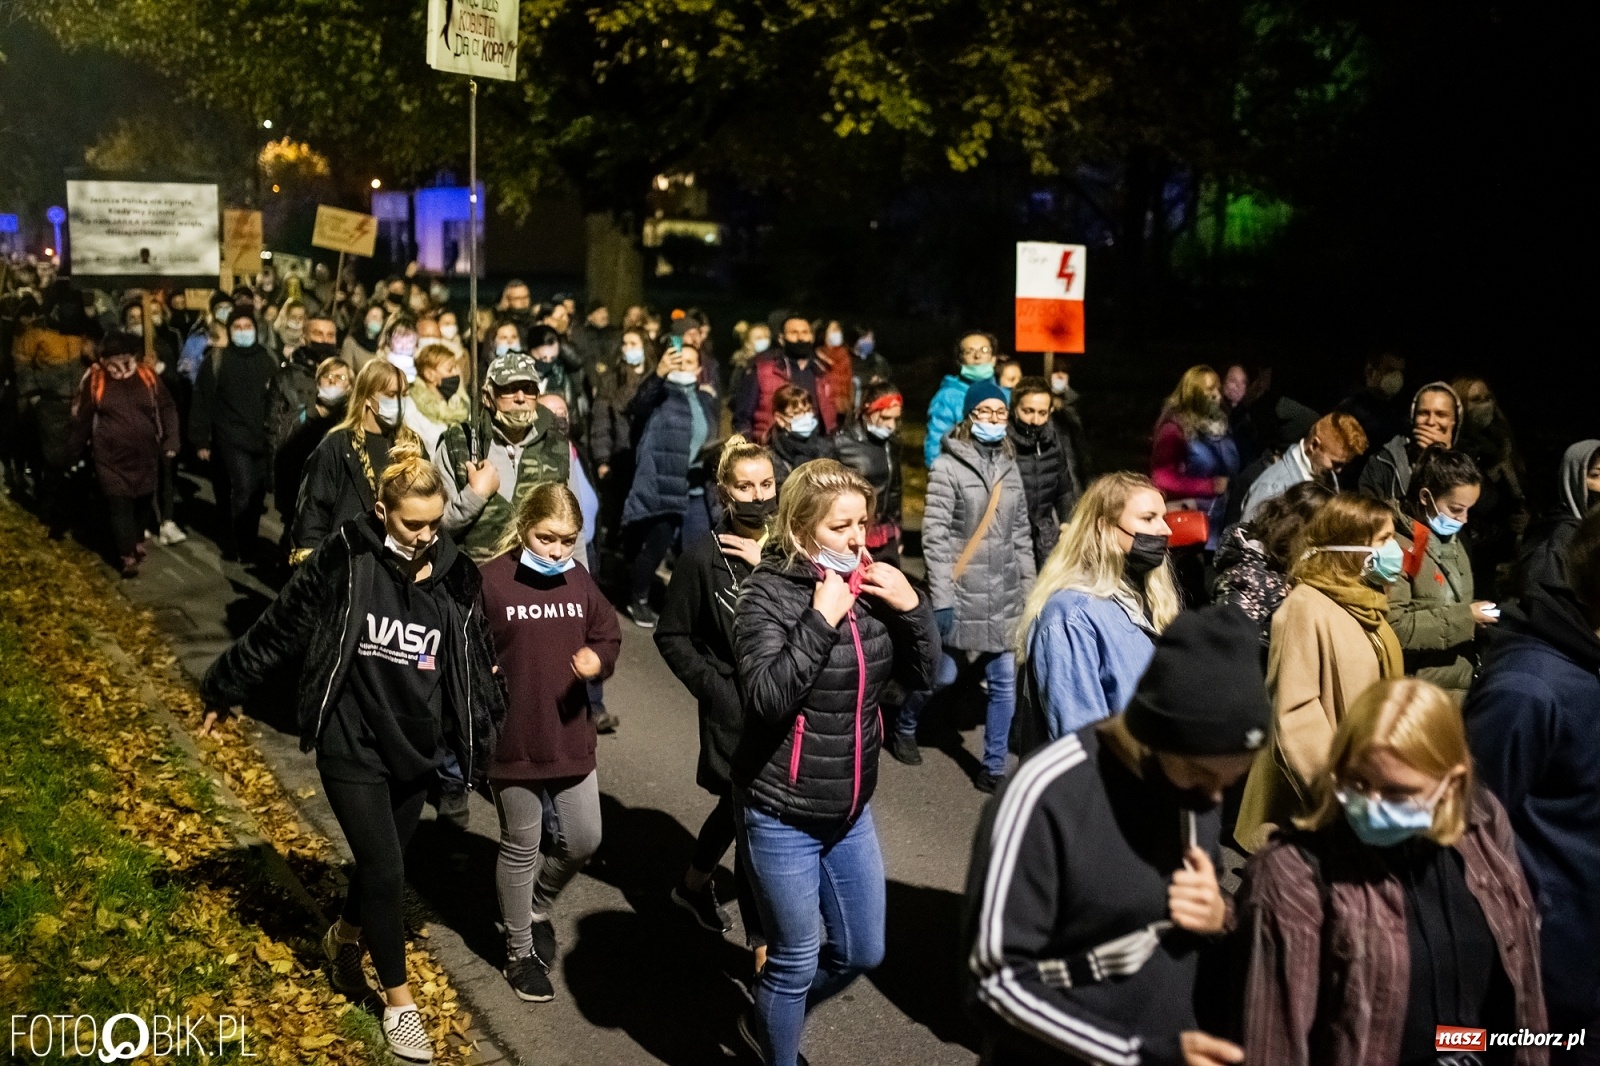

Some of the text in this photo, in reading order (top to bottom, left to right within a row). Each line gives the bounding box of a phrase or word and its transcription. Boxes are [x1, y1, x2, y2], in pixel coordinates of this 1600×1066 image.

[459, 10, 496, 38] KOBIETA
[454, 33, 469, 58] DA
[506, 602, 584, 621] PROMISE
[366, 612, 441, 655] NASA
